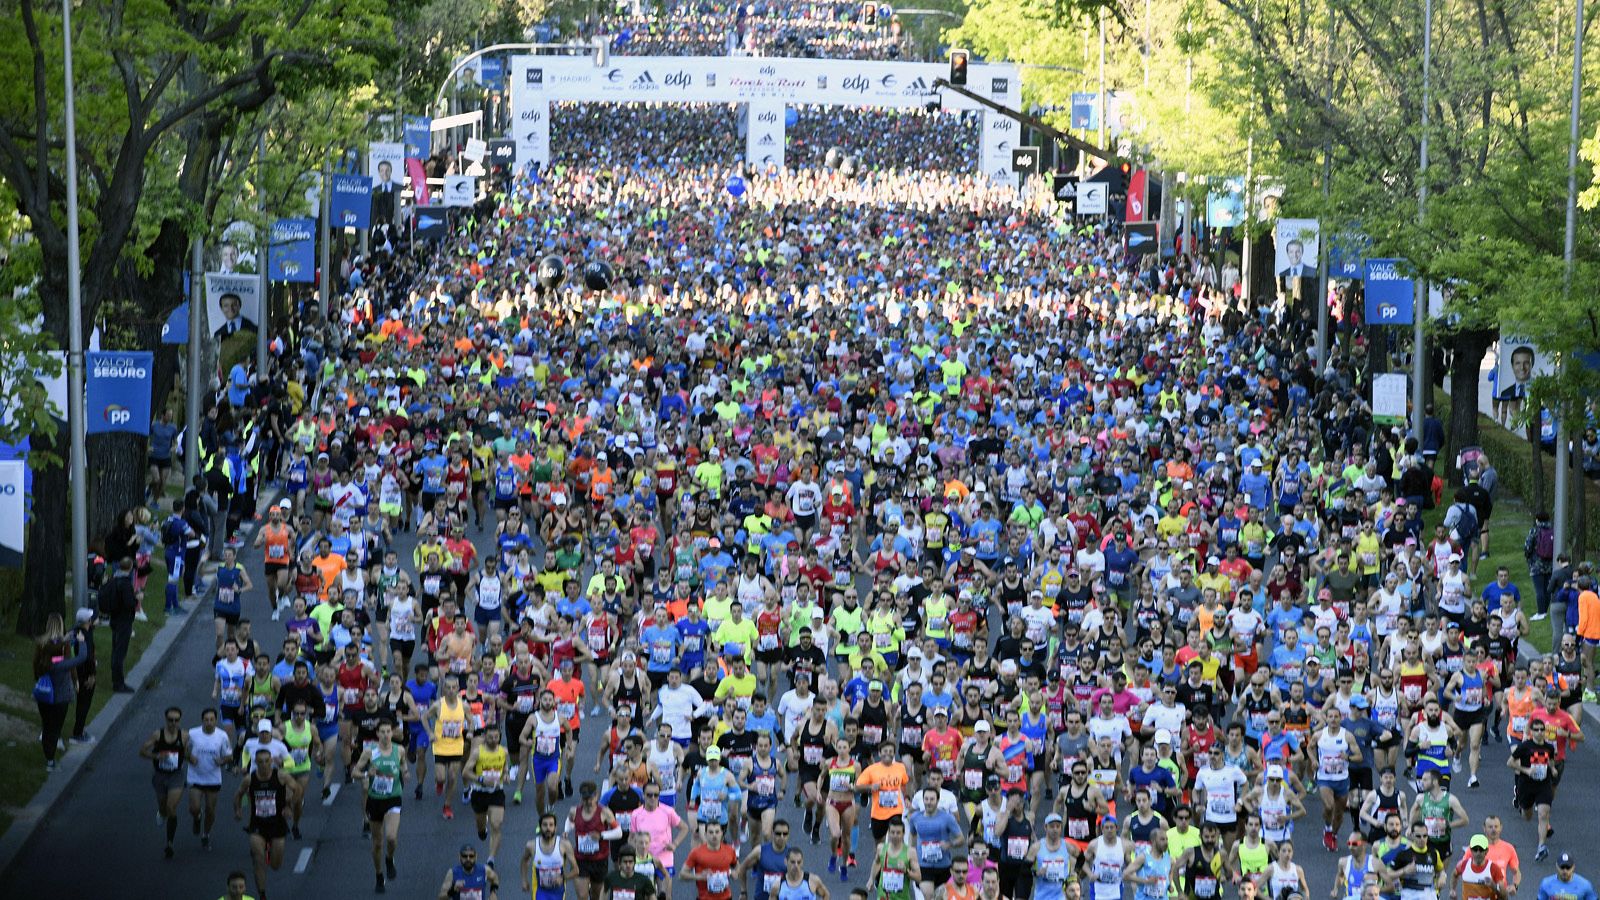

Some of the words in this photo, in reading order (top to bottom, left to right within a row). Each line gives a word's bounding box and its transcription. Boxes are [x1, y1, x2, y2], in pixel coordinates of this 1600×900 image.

[759, 65, 775, 76] edp
[664, 70, 692, 90] edp
[842, 74, 870, 95] edp
[521, 109, 540, 124] edp
[757, 110, 777, 125] edp
[992, 118, 1012, 132] edp
[496, 146, 512, 158] edp
[1016, 154, 1032, 168] edp
[337, 185, 368, 195] SEGURO
[344, 212, 357, 225] pp
[284, 266, 299, 278] pp
[1342, 264, 1357, 276] pp
[211, 286, 254, 295] CASADO
[1382, 306, 1398, 319] pp
[94, 357, 134, 368] VALOR
[94, 366, 146, 379] SEGURO
[111, 409, 131, 425] pp
